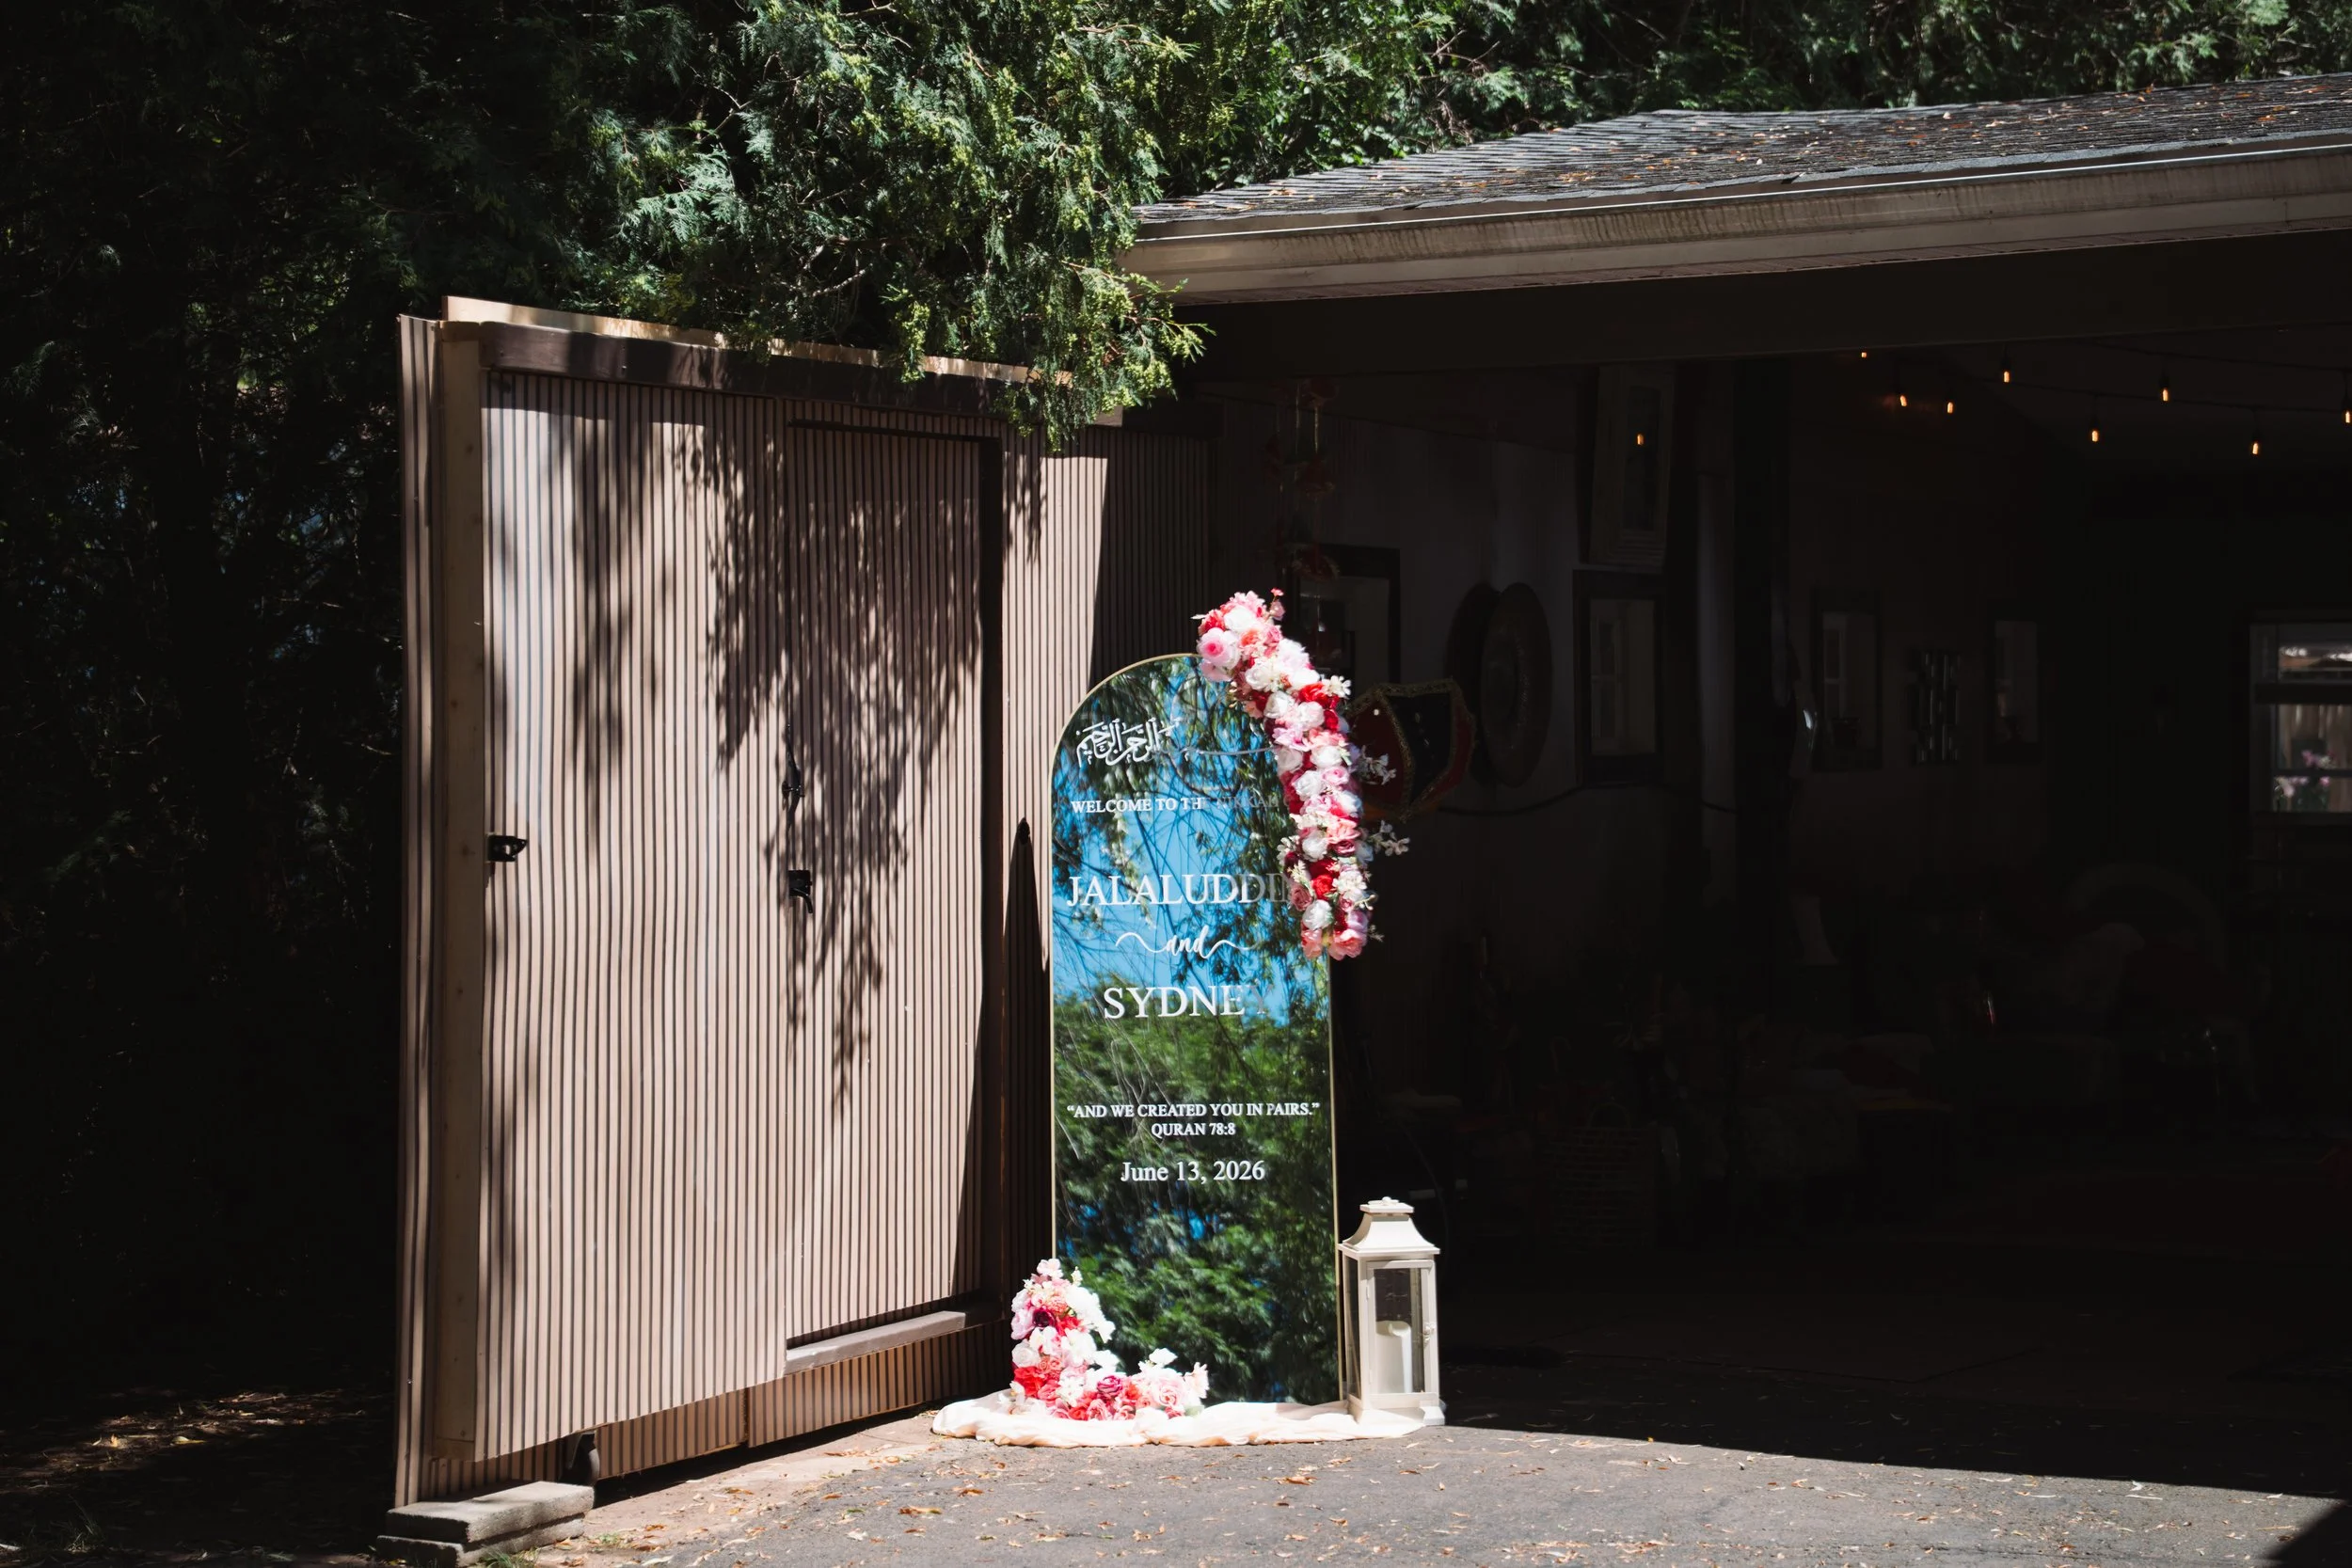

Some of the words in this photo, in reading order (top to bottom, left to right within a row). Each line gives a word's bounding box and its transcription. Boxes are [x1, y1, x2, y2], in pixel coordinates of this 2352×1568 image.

[1071, 798, 1152, 814] WELCOME
[1155, 798, 1177, 812] TO
[1104, 984, 1272, 1020] SYDNEY
[1067, 1104, 1107, 1118] “AND
[1111, 1104, 1135, 1117] WE
[1137, 1103, 1207, 1117] CREATED
[1210, 1103, 1244, 1117] YOU
[1247, 1102, 1263, 1117] IN
[1266, 1102, 1321, 1117] PAIRS.”
[1151, 1122, 1206, 1139] QURAN
[1209, 1122, 1236, 1136] 78:8
[1120, 1162, 1169, 1181] June
[1176, 1161, 1207, 1184] 13,
[1213, 1160, 1266, 1181] 2026
